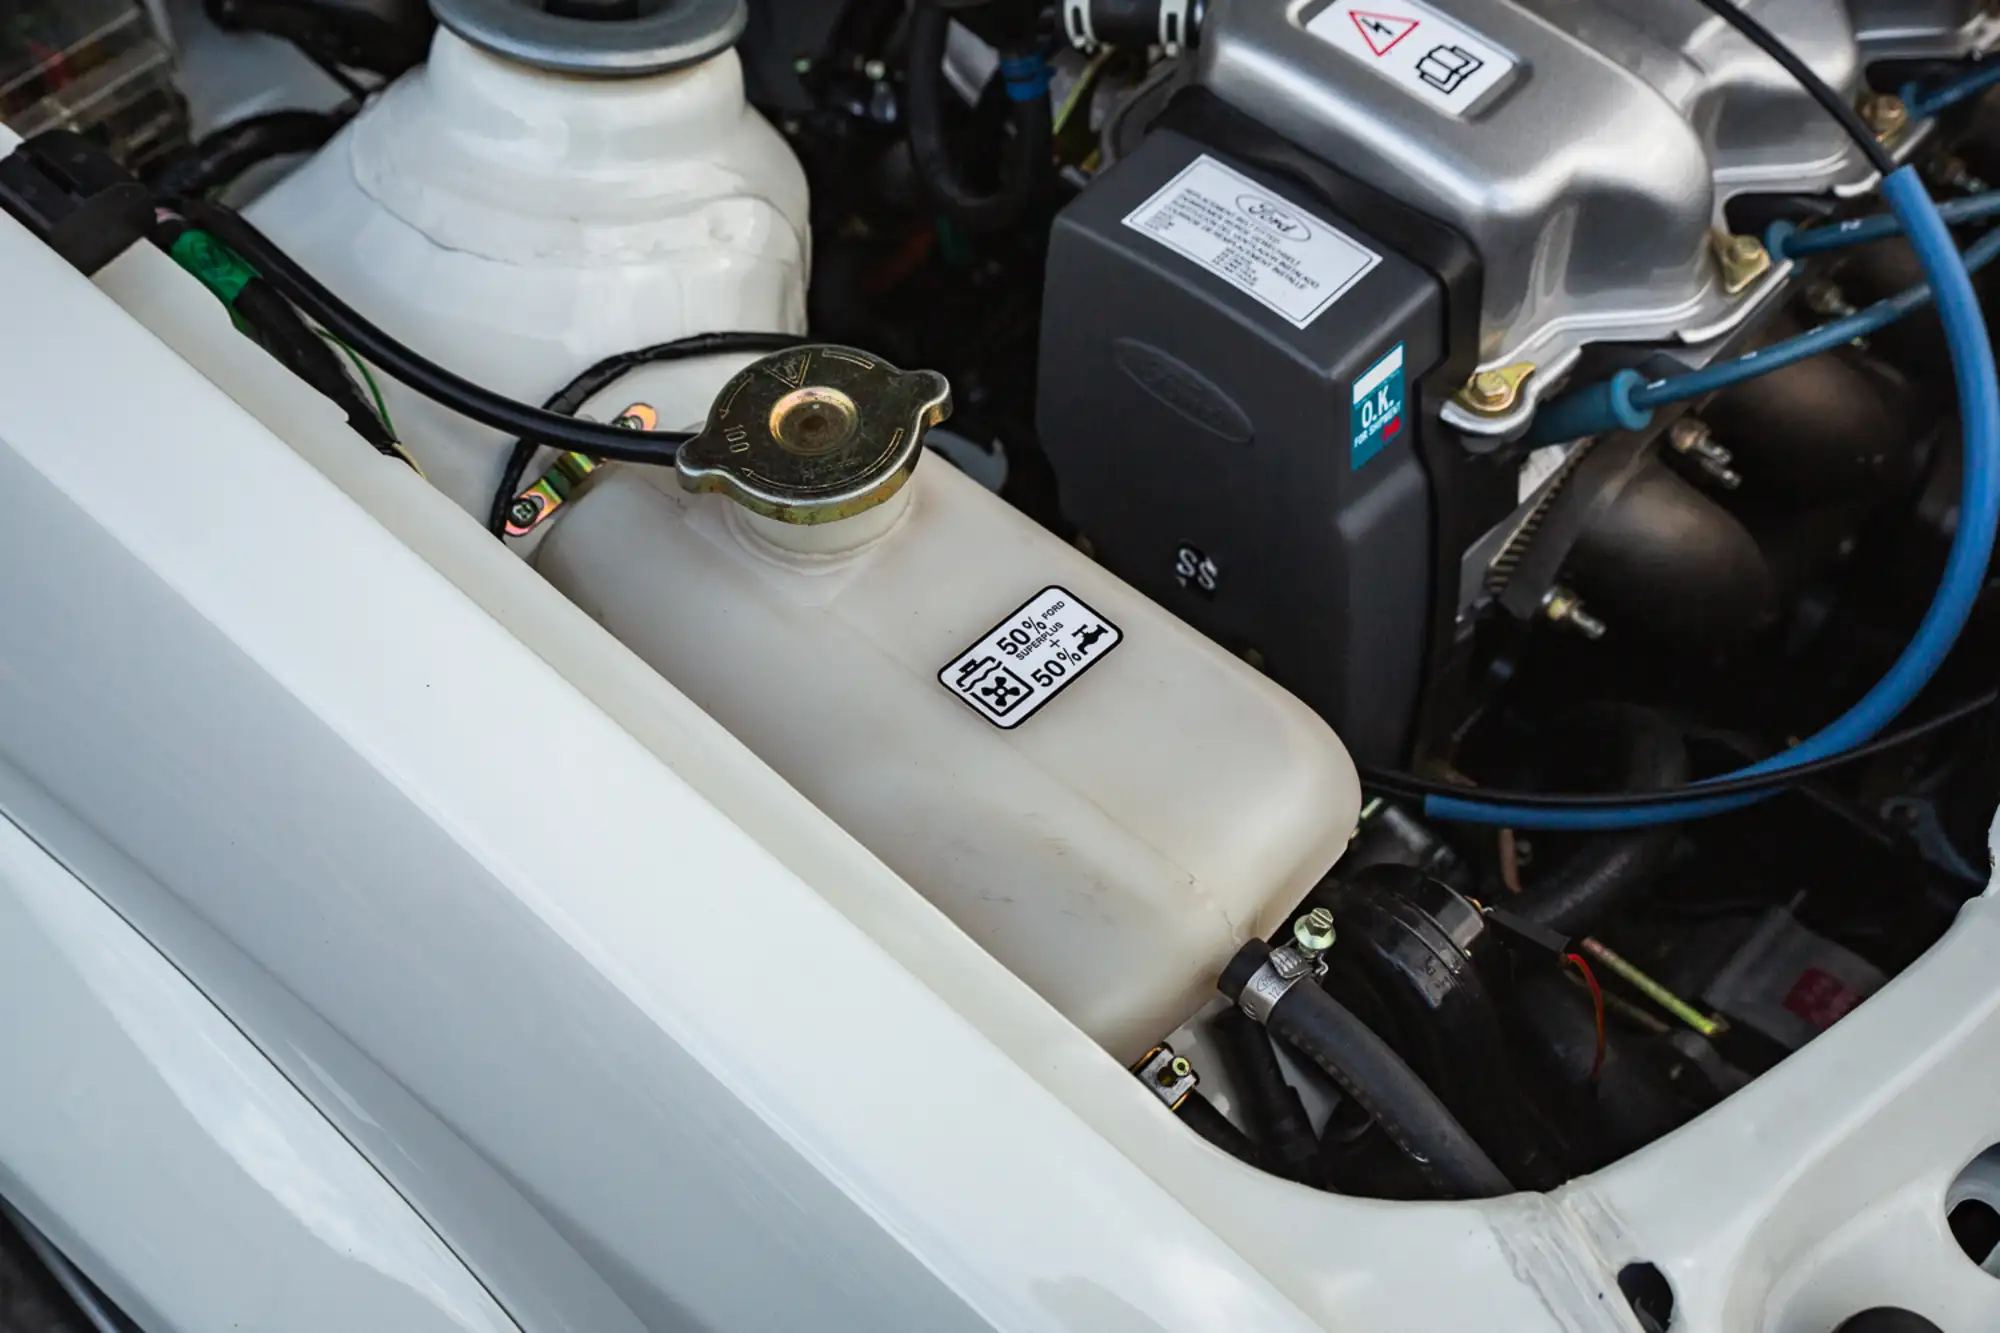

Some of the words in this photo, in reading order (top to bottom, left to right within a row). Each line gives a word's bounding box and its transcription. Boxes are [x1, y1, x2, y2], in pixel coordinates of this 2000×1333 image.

[1248, 201, 1298, 232] Ford
[1362, 384, 1394, 429] O.K.
[723, 424, 751, 454] 100
[996, 616, 1047, 656] 50%
[1041, 600, 1065, 621] FORD
[1015, 621, 1064, 661] SUPERPLUS
[1030, 647, 1082, 688] 50%
